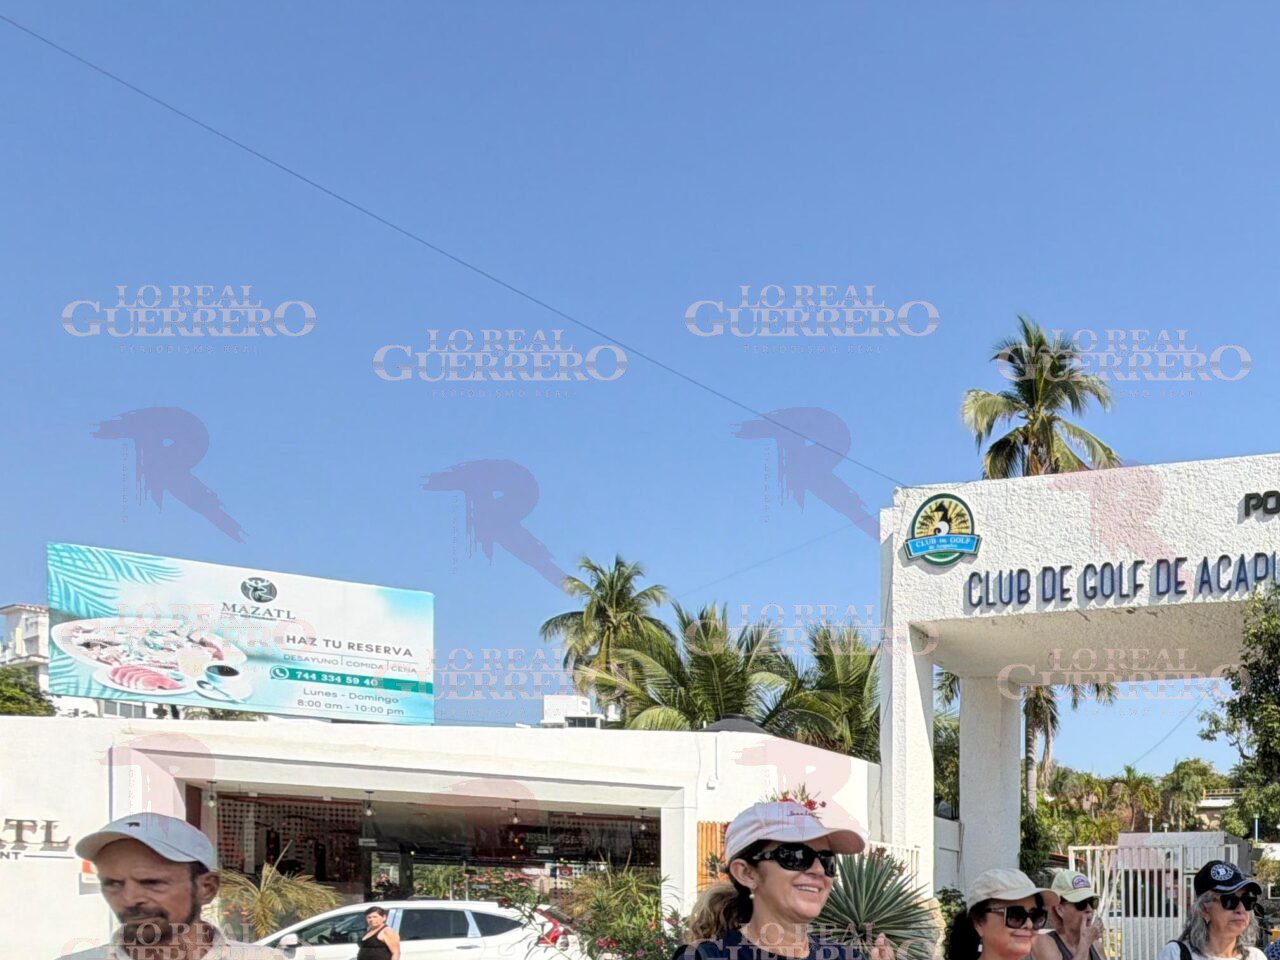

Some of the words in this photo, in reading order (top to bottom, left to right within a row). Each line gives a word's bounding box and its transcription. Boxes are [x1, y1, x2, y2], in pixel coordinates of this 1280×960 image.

[967, 569, 1031, 608] CLUB
[1041, 564, 1073, 603] DE
[1083, 559, 1146, 600] GOLF
[1155, 556, 1189, 596] DE
[221, 602, 296, 620] MAZATL
[286, 635, 318, 647] HAZ
[322, 639, 342, 649] TU
[347, 642, 413, 657] RESERVA
[283, 653, 339, 666] DESAYUNO
[345, 660, 384, 670] COMIDA
[391, 666, 417, 674] CENA
[295, 671, 317, 681] 744
[321, 673, 341, 683] 334
[346, 676, 360, 685] 59
[303, 687, 338, 698] Lunes
[349, 692, 399, 704] Domingo
[297, 699, 322, 708] 8:00
[325, 701, 343, 710] am
[355, 704, 384, 714] 10:00
[387, 707, 404, 716] pm
